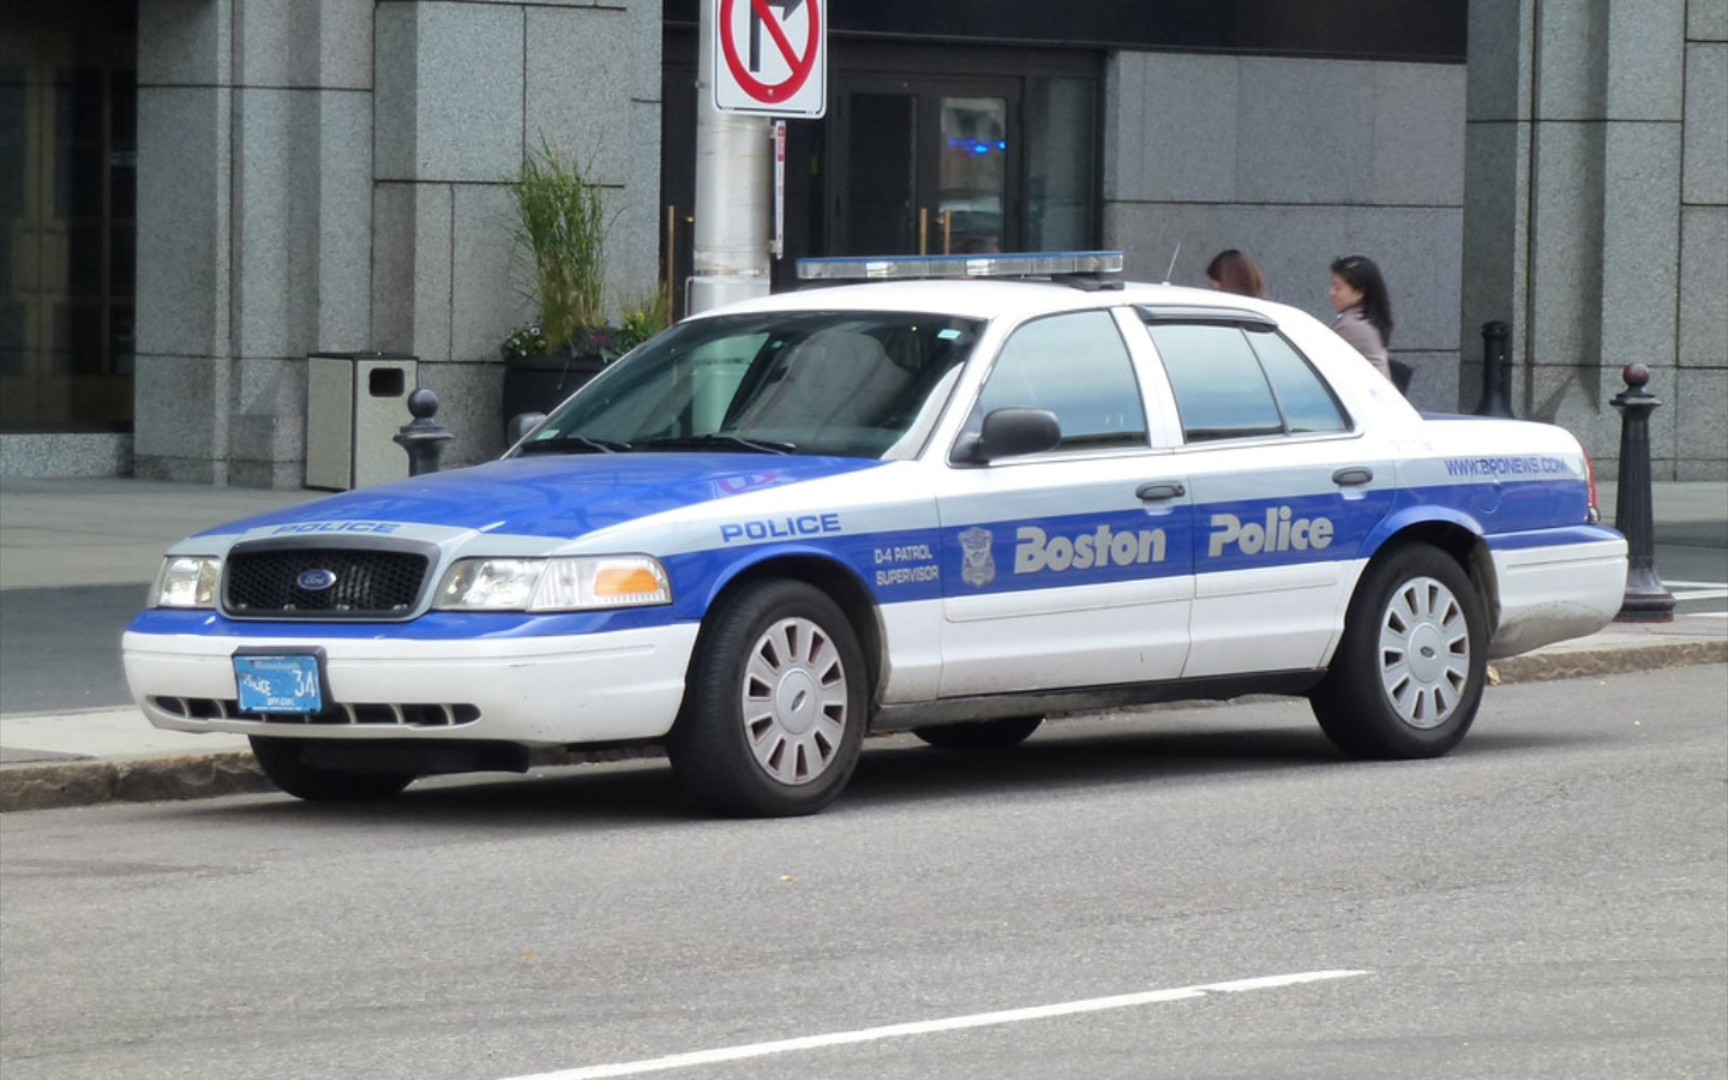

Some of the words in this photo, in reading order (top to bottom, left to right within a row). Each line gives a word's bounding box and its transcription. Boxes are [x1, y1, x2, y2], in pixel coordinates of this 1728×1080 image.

[272, 522, 400, 535] POLICE
[719, 512, 841, 542] POLICE
[1014, 525, 1167, 574] Boston
[1208, 506, 1334, 557] Police
[895, 545, 932, 561] PATROL
[877, 566, 939, 586] SUPERVISOR
